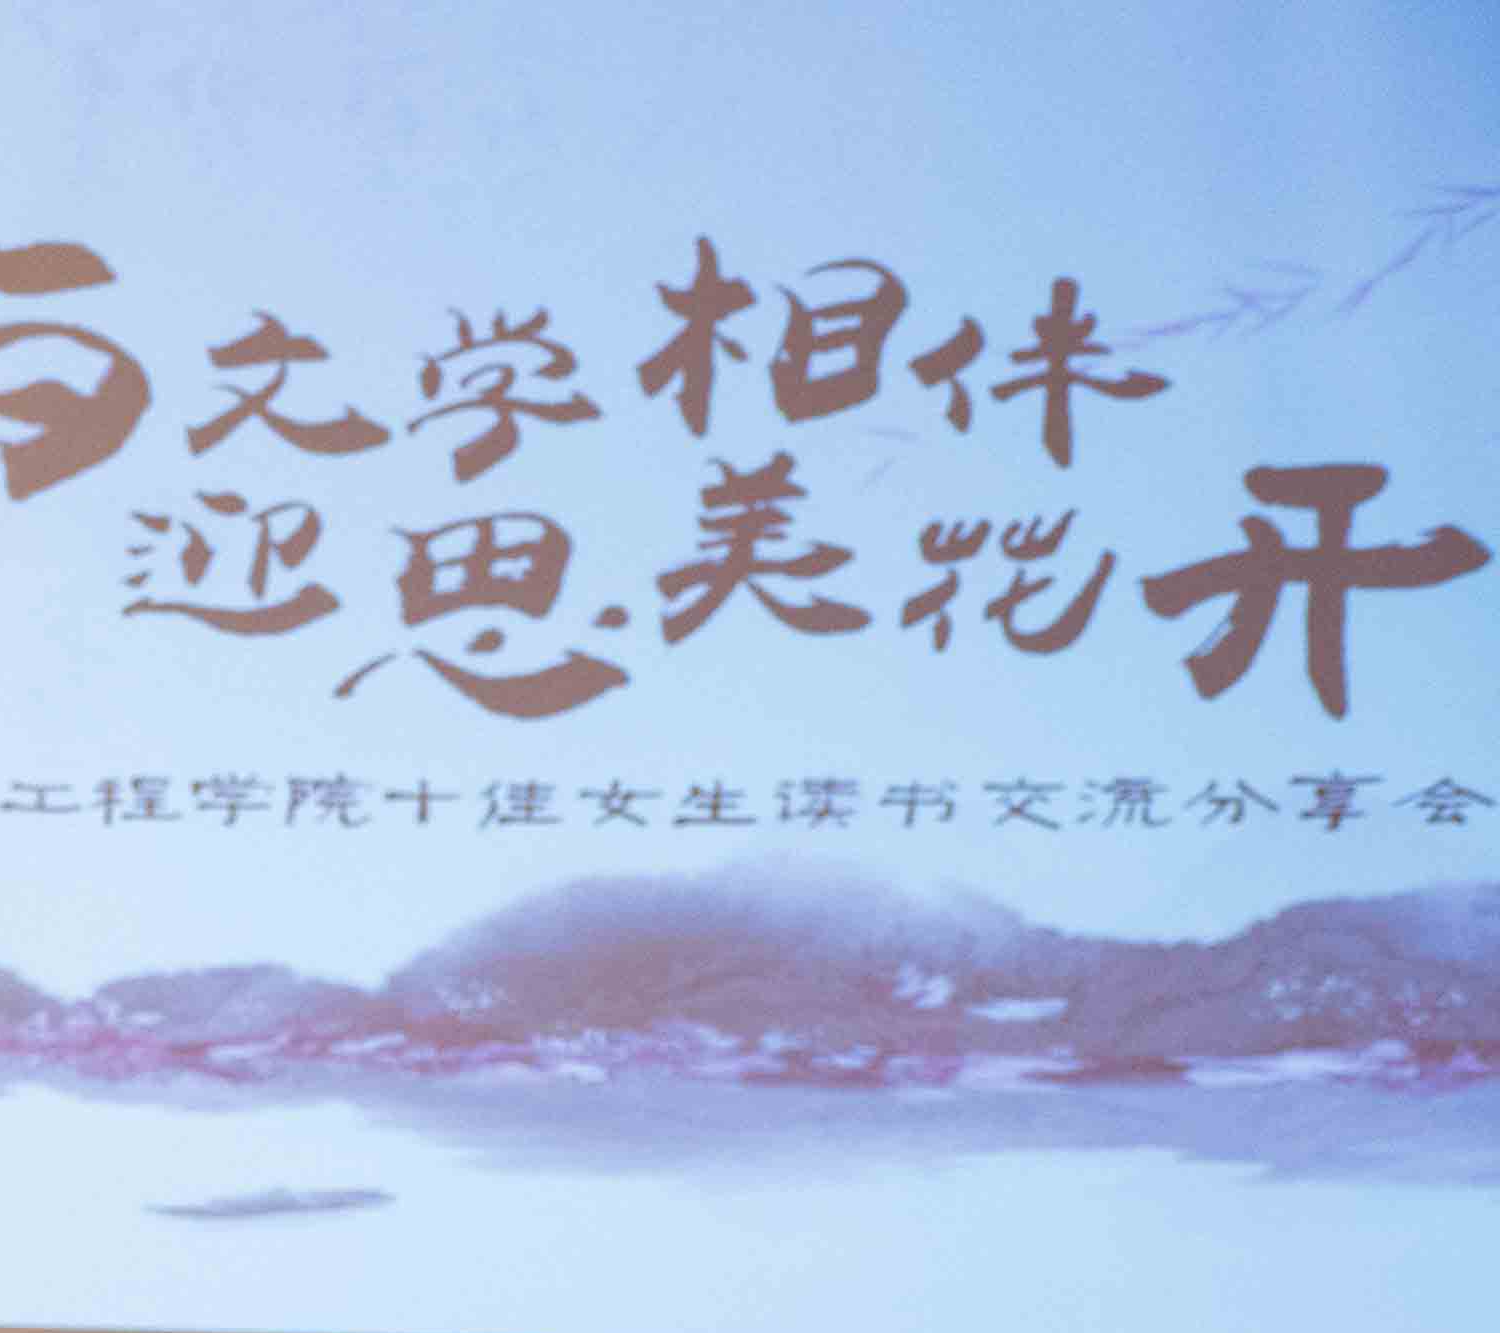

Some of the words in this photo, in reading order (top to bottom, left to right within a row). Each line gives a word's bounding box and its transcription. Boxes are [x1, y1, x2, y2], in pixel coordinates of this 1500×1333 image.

[121, 450, 1493, 720] 迎思美花开
